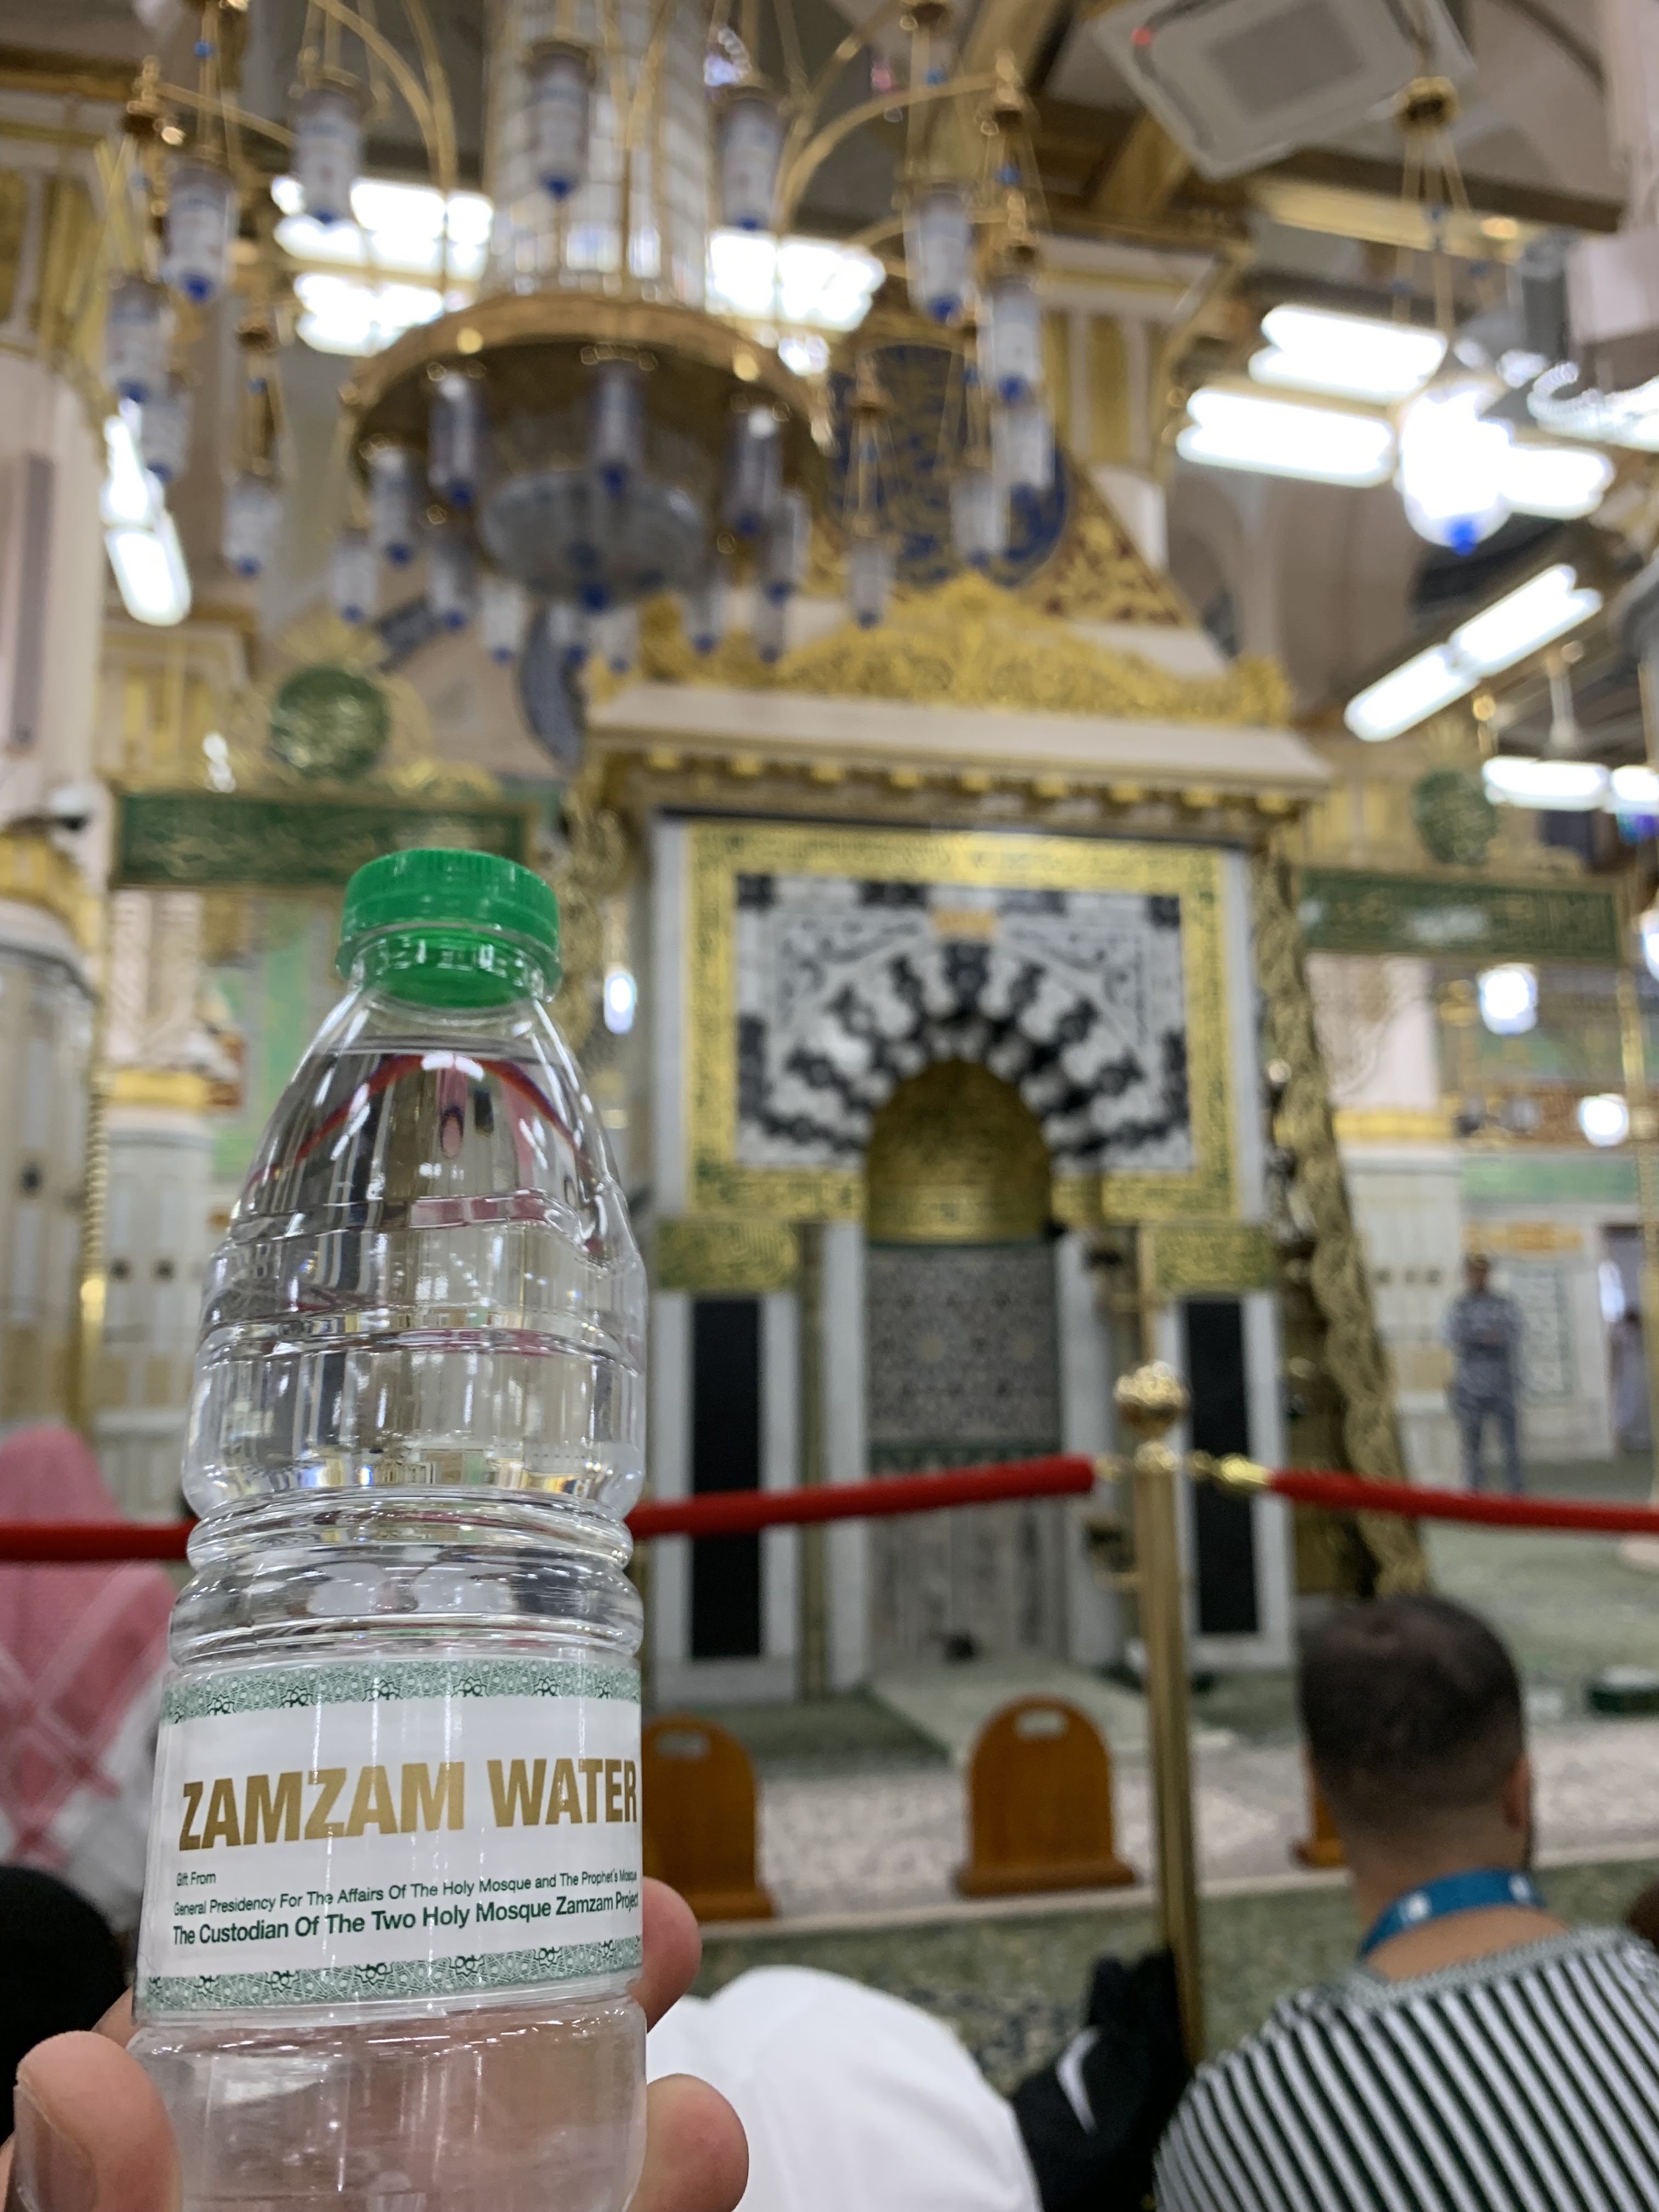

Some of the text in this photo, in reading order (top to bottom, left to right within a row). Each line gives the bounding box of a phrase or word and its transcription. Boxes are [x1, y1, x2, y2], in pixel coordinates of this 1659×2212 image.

[179, 1758, 637, 1851] ZAMZAM WATER
[174, 1900, 206, 1916] General
[210, 1897, 276, 1914] Presidency
[280, 1893, 303, 1908] For
[306, 1891, 334, 1906] The
[337, 1887, 384, 1903] Affairs
[388, 1884, 406, 1899] Of
[410, 1883, 438, 1898] The
[443, 1880, 475, 1896] Holy
[479, 1878, 532, 1893] Mosque
[535, 1874, 556, 1888] and
[560, 1872, 579, 1886] The
[582, 1869, 618, 1886] Prophet's
[190, 1871, 216, 1885] From
[173, 1890, 639, 1945] The Custodian Of The Two Holy Mosque Zamzam Project
